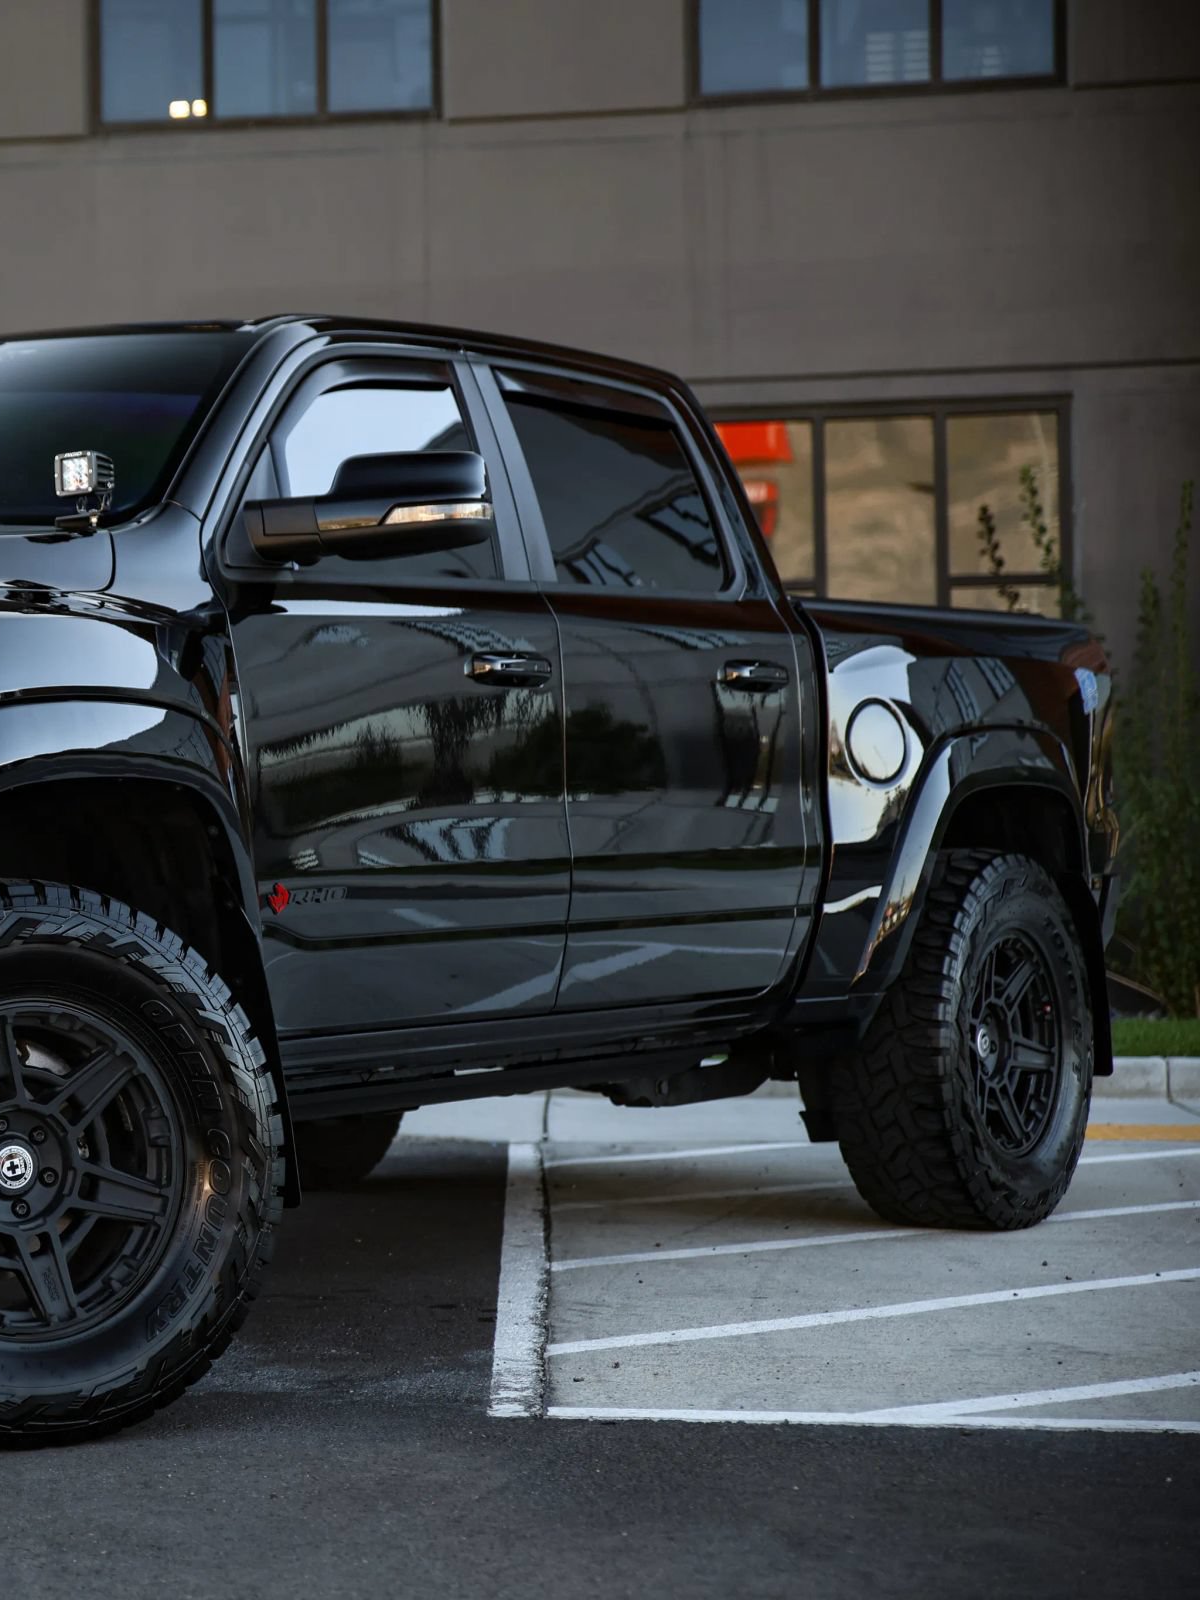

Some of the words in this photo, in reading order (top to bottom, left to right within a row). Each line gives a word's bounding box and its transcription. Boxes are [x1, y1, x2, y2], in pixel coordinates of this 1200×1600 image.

[289, 886, 350, 905] RHO
[138, 998, 224, 1112] OPEN
[146, 1128, 232, 1341] COUNTRY
